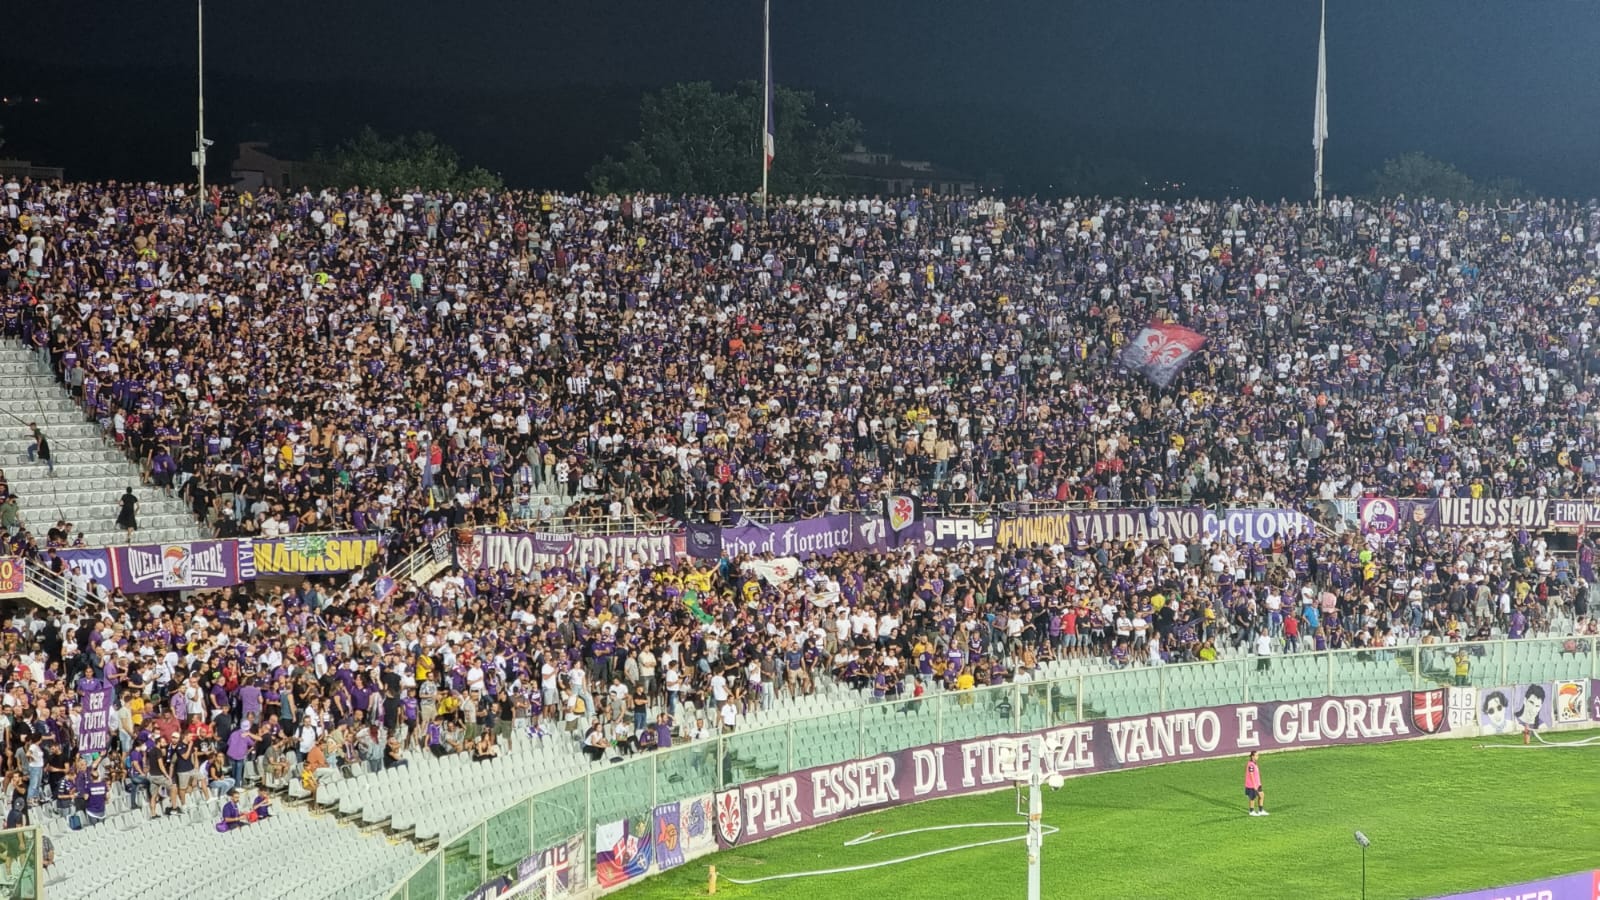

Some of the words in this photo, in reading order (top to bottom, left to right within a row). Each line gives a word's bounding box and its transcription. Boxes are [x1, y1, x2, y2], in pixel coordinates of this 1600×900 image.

[1440, 498, 1548, 527] VIEUSSEUX
[1556, 503, 1600, 521] FIRENZ
[781, 526, 849, 556] Florence
[997, 514, 1070, 549] AFICIONADOS
[89, 692, 105, 710] PER
[84, 710, 106, 730] TUTTA
[79, 733, 88, 751] LA
[89, 731, 106, 749] VITA
[744, 776, 800, 836] PER
[811, 756, 900, 818] ESSER
[913, 747, 948, 796] DI
[1108, 710, 1222, 764] VANTO
[1236, 706, 1260, 748] E
[1272, 696, 1410, 744] GLORIA
